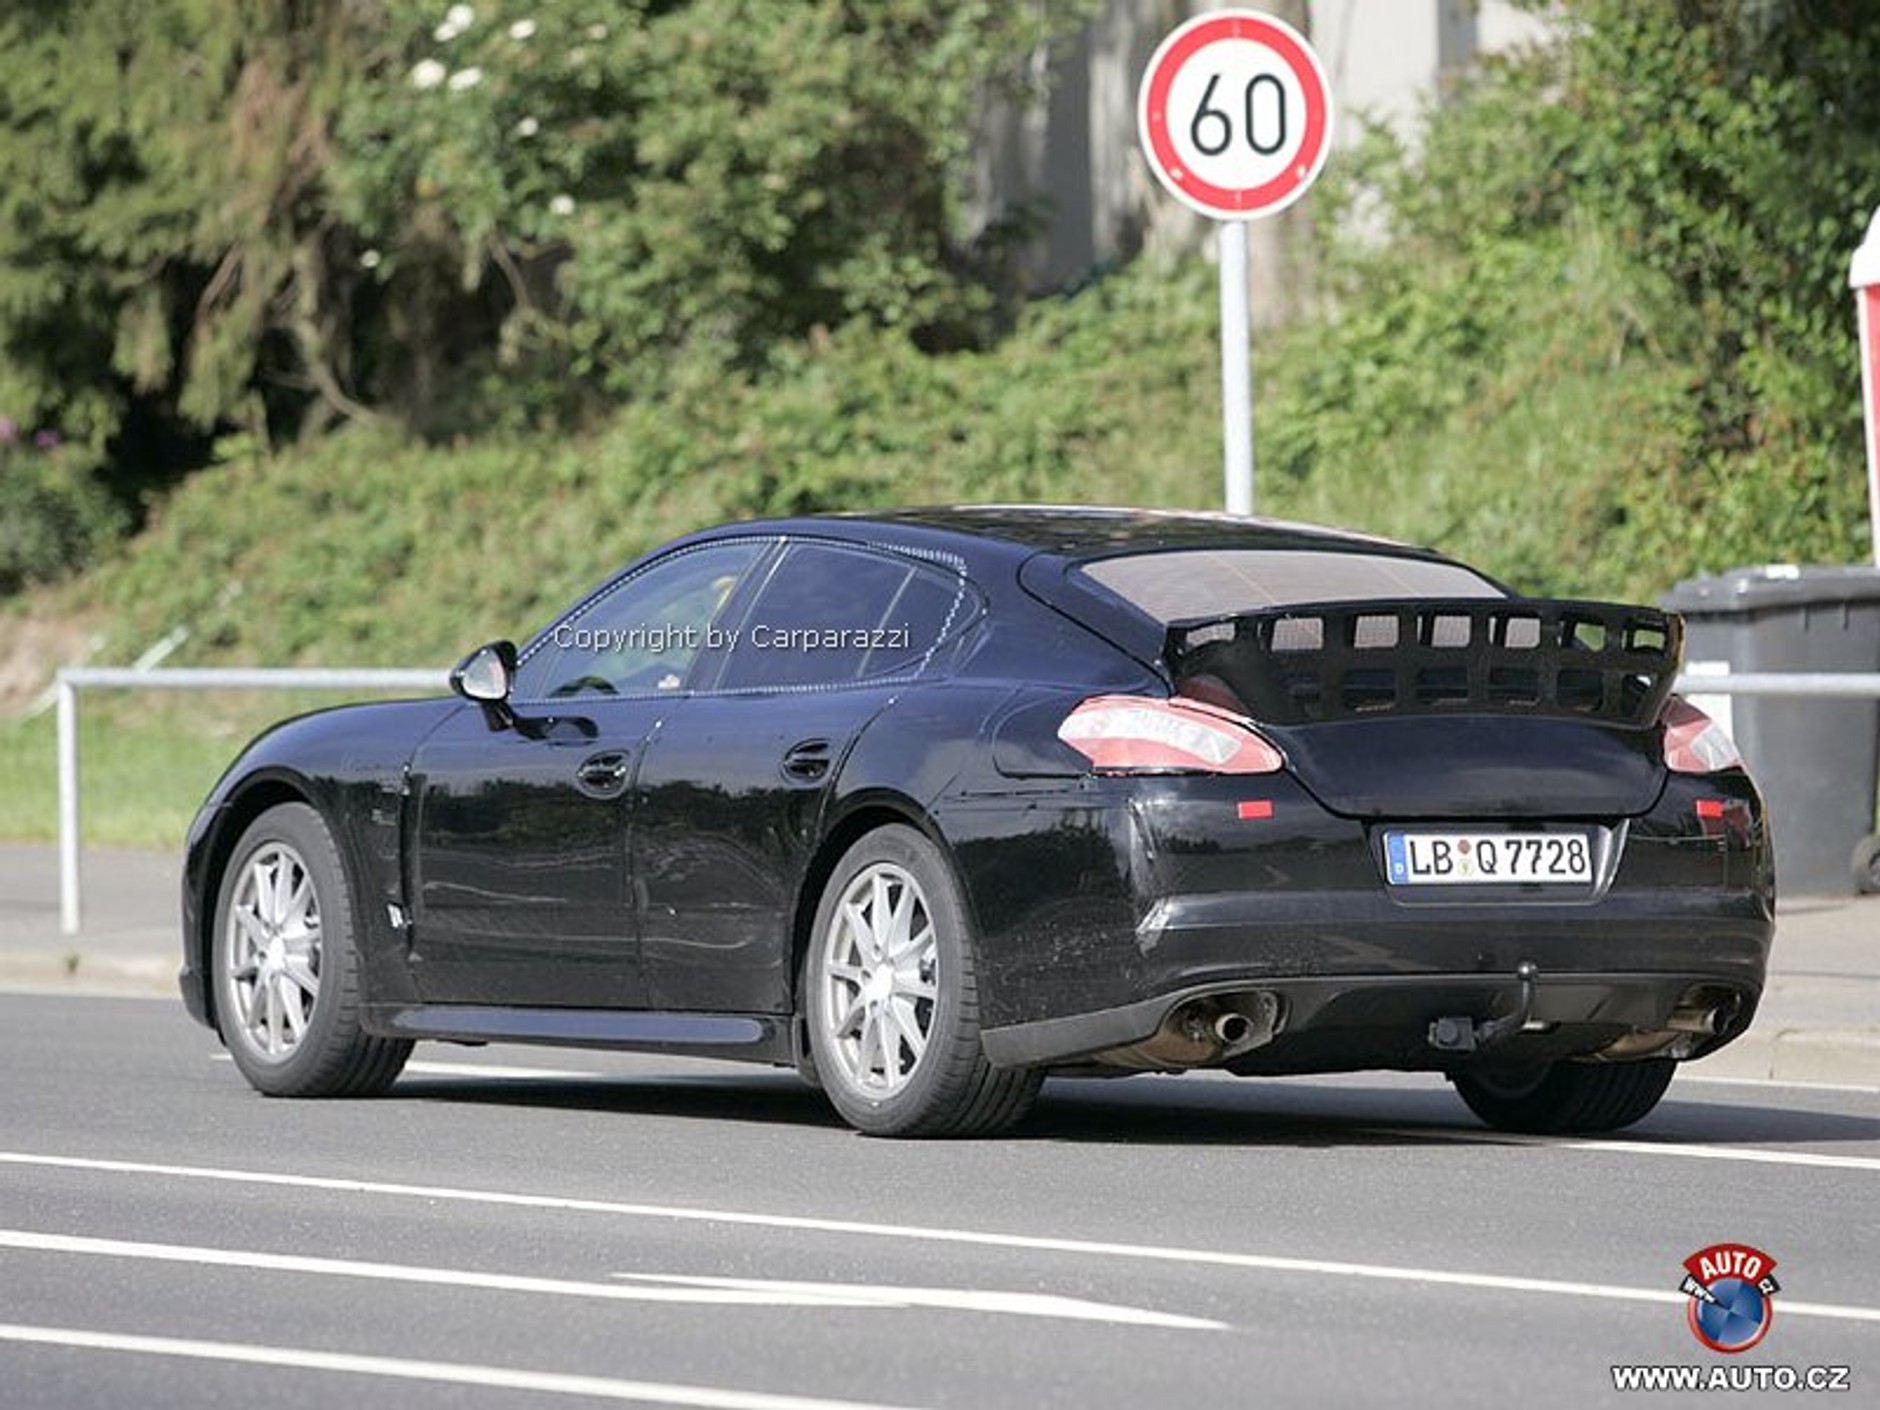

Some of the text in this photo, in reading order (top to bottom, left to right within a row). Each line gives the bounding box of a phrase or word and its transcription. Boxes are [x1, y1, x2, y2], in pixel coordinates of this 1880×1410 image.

[1190, 73, 1286, 156] 60
[1409, 840, 1454, 876] LB
[1505, 839, 1586, 875] 7728
